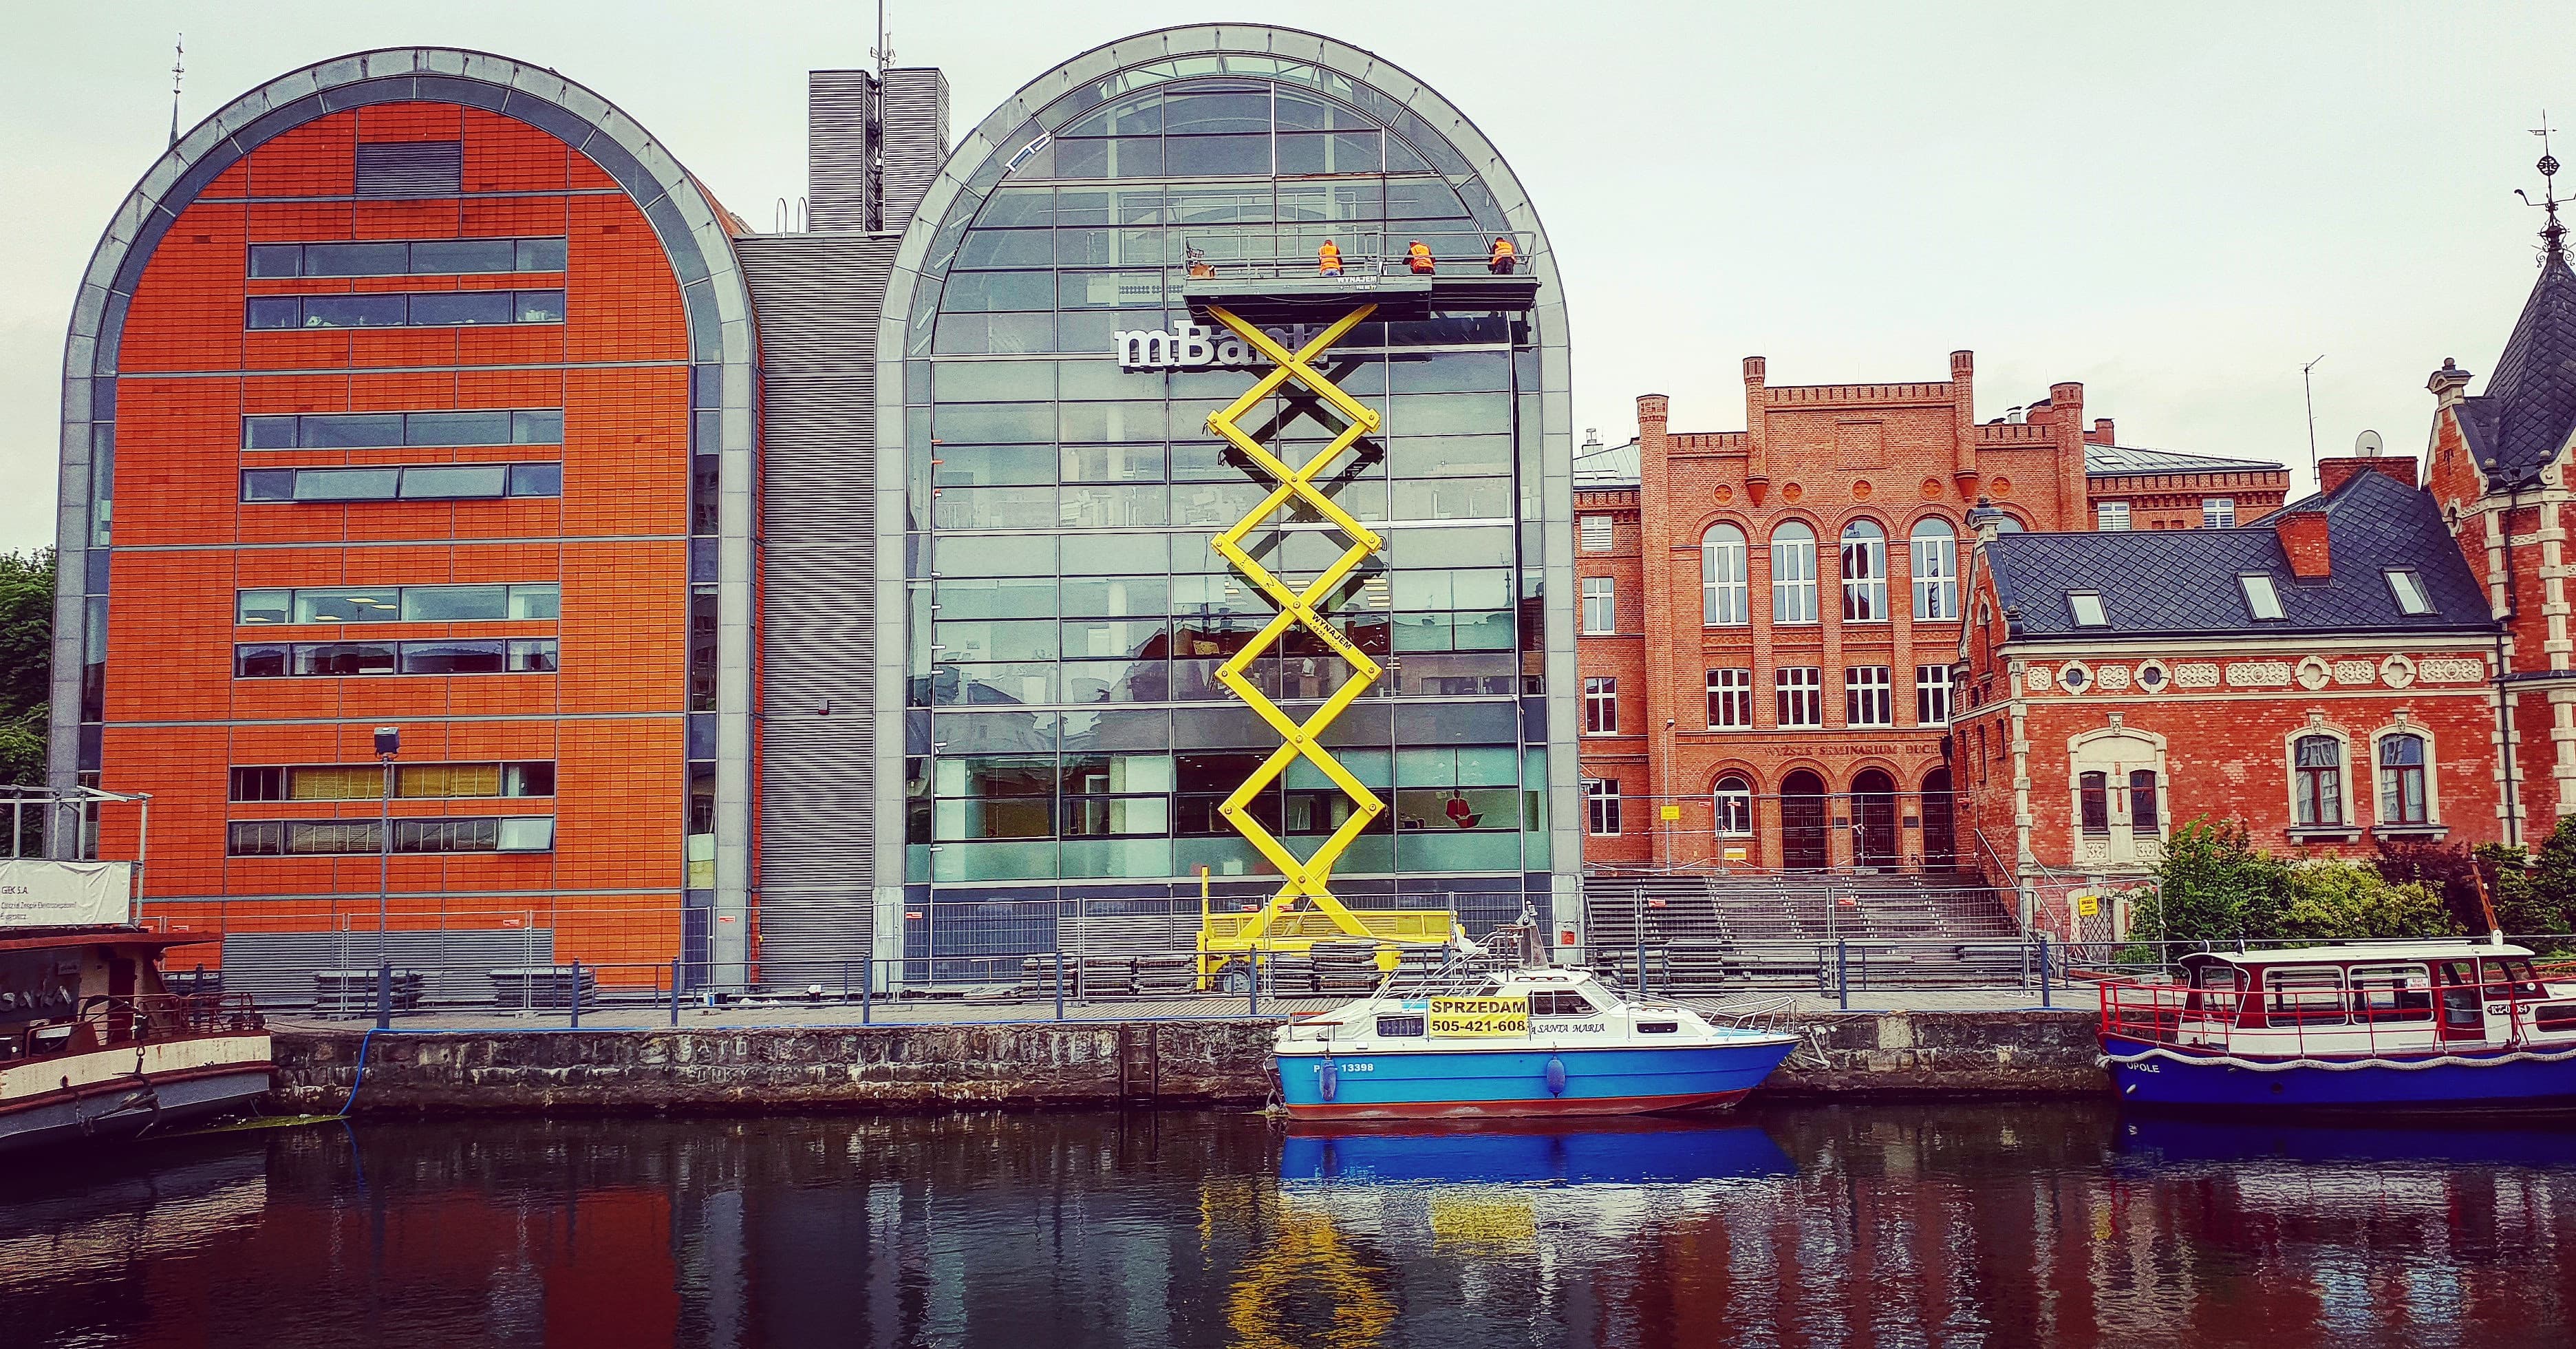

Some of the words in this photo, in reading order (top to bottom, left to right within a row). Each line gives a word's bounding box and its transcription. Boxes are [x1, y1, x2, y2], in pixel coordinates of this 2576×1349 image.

[1312, 613, 1353, 650] WYNAJEM
[1905, 744, 1940, 754] DUCH
[1432, 1001, 1526, 1013] SPRZEDAM
[1432, 1020, 1526, 1032] 505-421-608
[1538, 1024, 1569, 1033] SANTA
[1572, 1023, 1606, 1033] MARIA
[1341, 1063, 1375, 1072] 13398
[2126, 1062, 2160, 1073] OPOLE
